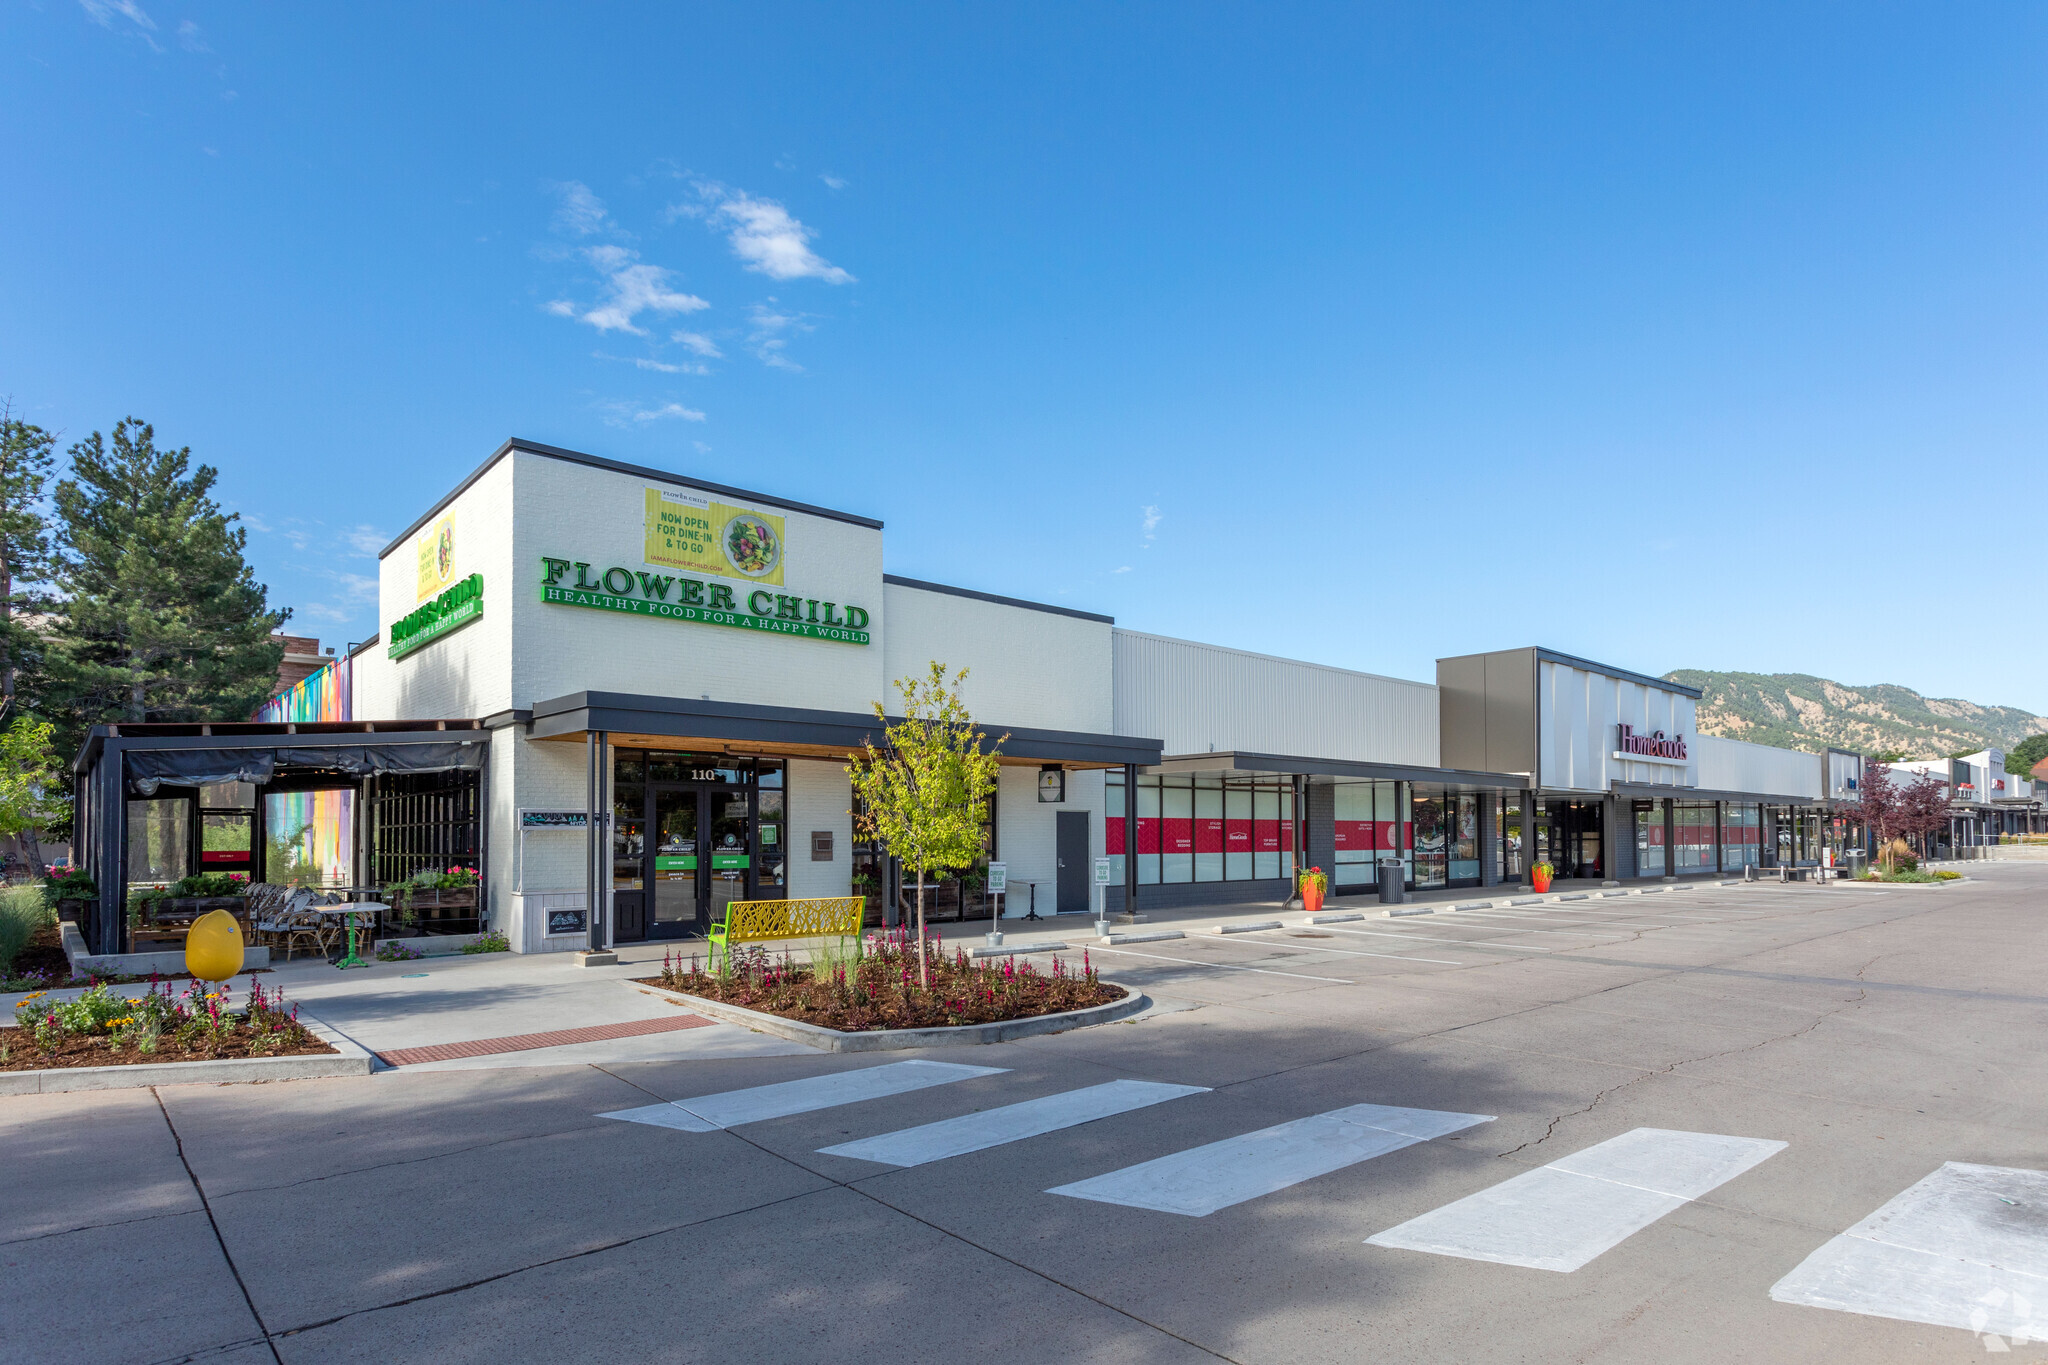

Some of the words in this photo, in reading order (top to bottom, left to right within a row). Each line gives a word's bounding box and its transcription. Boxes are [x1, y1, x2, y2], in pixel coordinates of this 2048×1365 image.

[663, 490, 688, 500] FLOWER
[688, 496, 708, 504] CHILD
[661, 511, 682, 525] NOW
[684, 516, 709, 530] OPEN
[657, 523, 676, 536] FOR
[678, 527, 712, 543] DINE-IN
[666, 538, 673, 548] &
[676, 540, 688, 551] TO
[690, 543, 704, 554] GO
[650, 554, 723, 572] IAMAFLOWERCHILD.COM
[541, 556, 736, 611] FLOWER
[748, 590, 869, 630] CHILD
[453, 602, 474, 620] WORLD
[547, 588, 641, 611] HEALTHY
[648, 603, 696, 618] FOOD
[702, 611, 736, 625] FOR
[742, 617, 752, 627] A
[758, 618, 810, 635] HAPPY
[816, 626, 868, 643] WORLD
[1617, 723, 1688, 761] HomeGoods
[691, 769, 715, 781] 110
